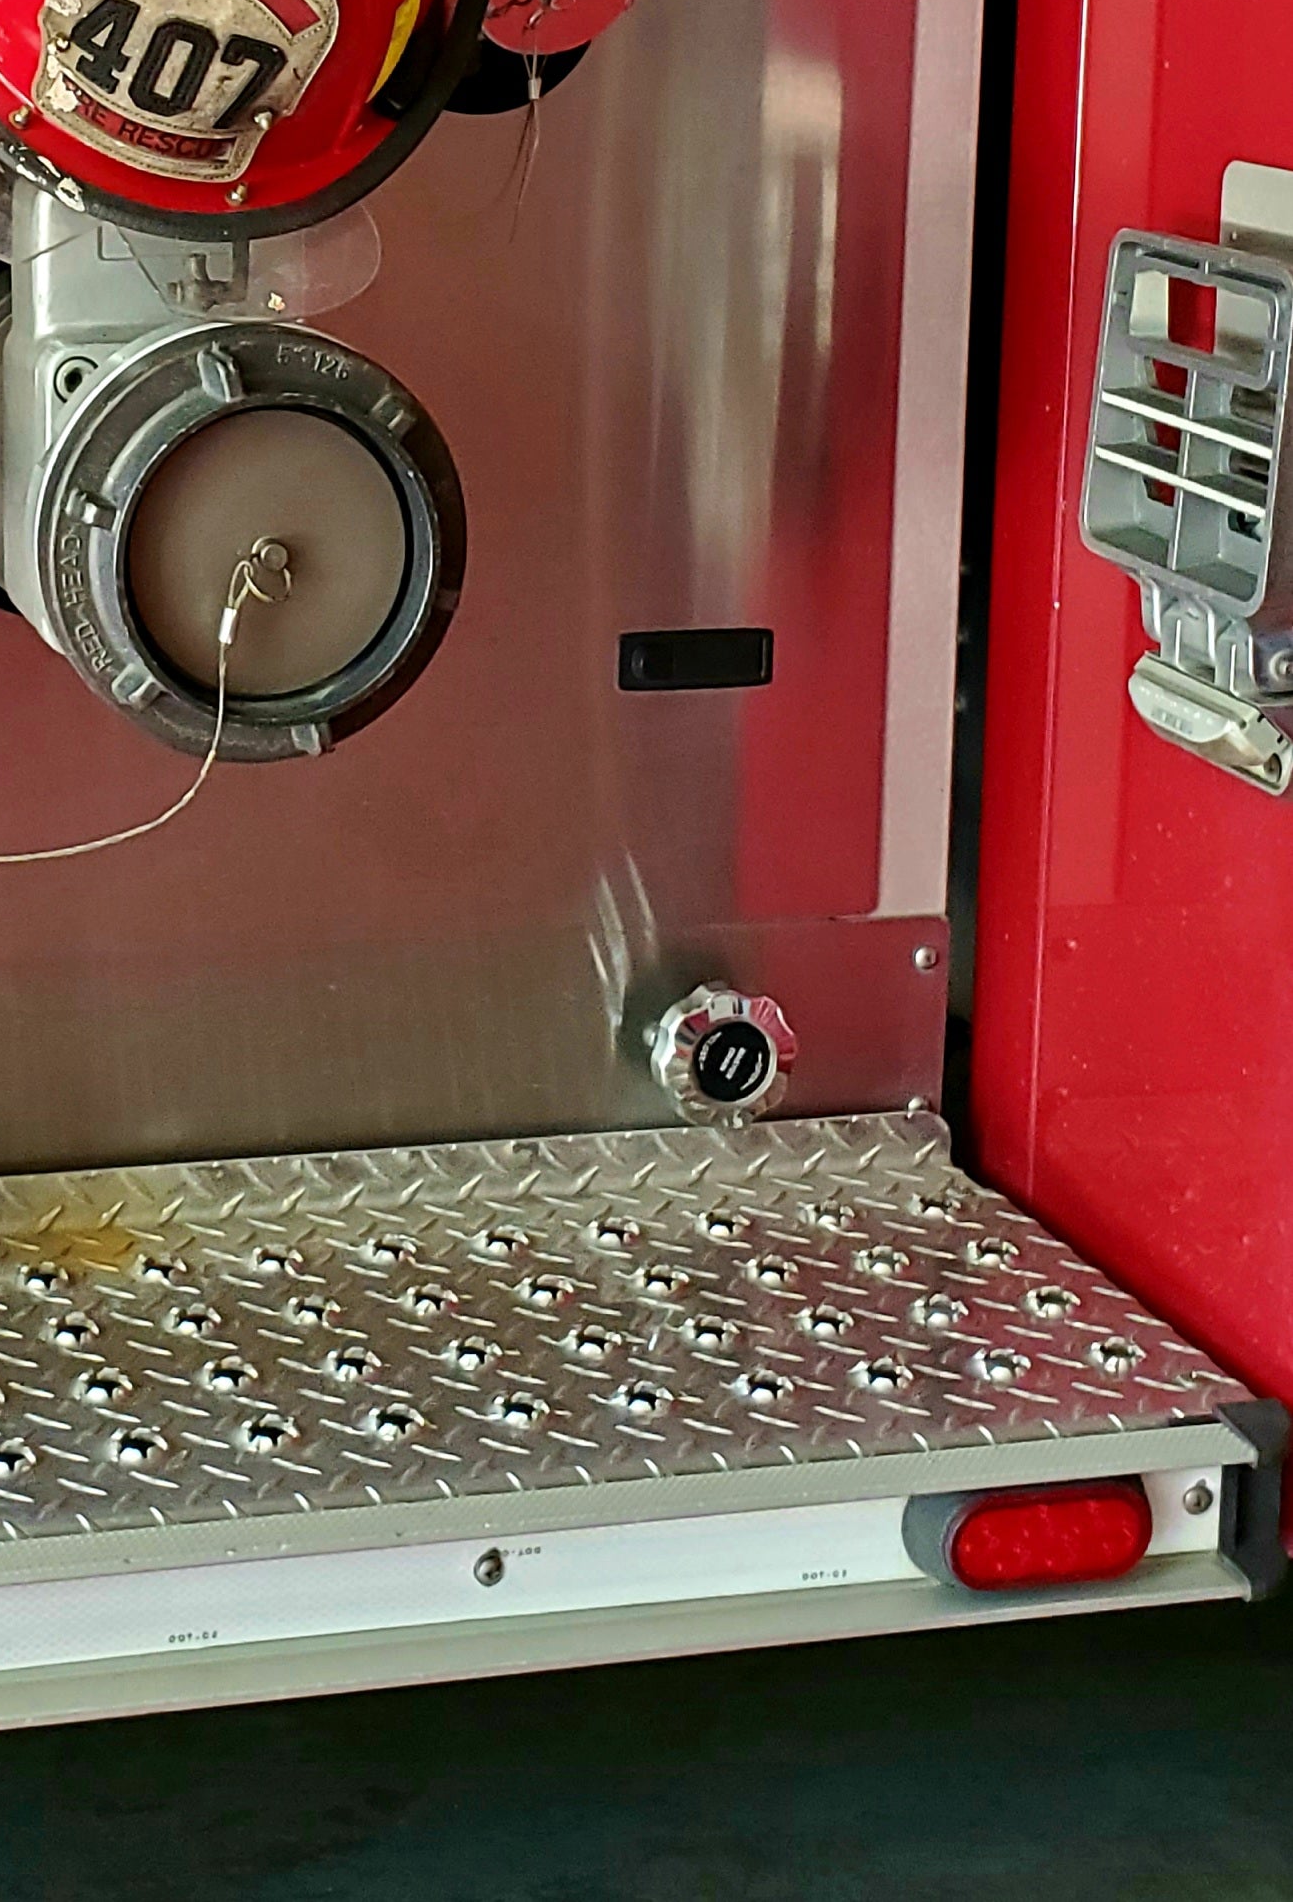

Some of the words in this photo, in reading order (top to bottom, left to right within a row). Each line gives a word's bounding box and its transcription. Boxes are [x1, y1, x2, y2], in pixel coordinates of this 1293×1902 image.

[59, 530, 85, 609] HEAD
[73, 620, 114, 673] RED
[502, 1546, 541, 1557] DOT-C
